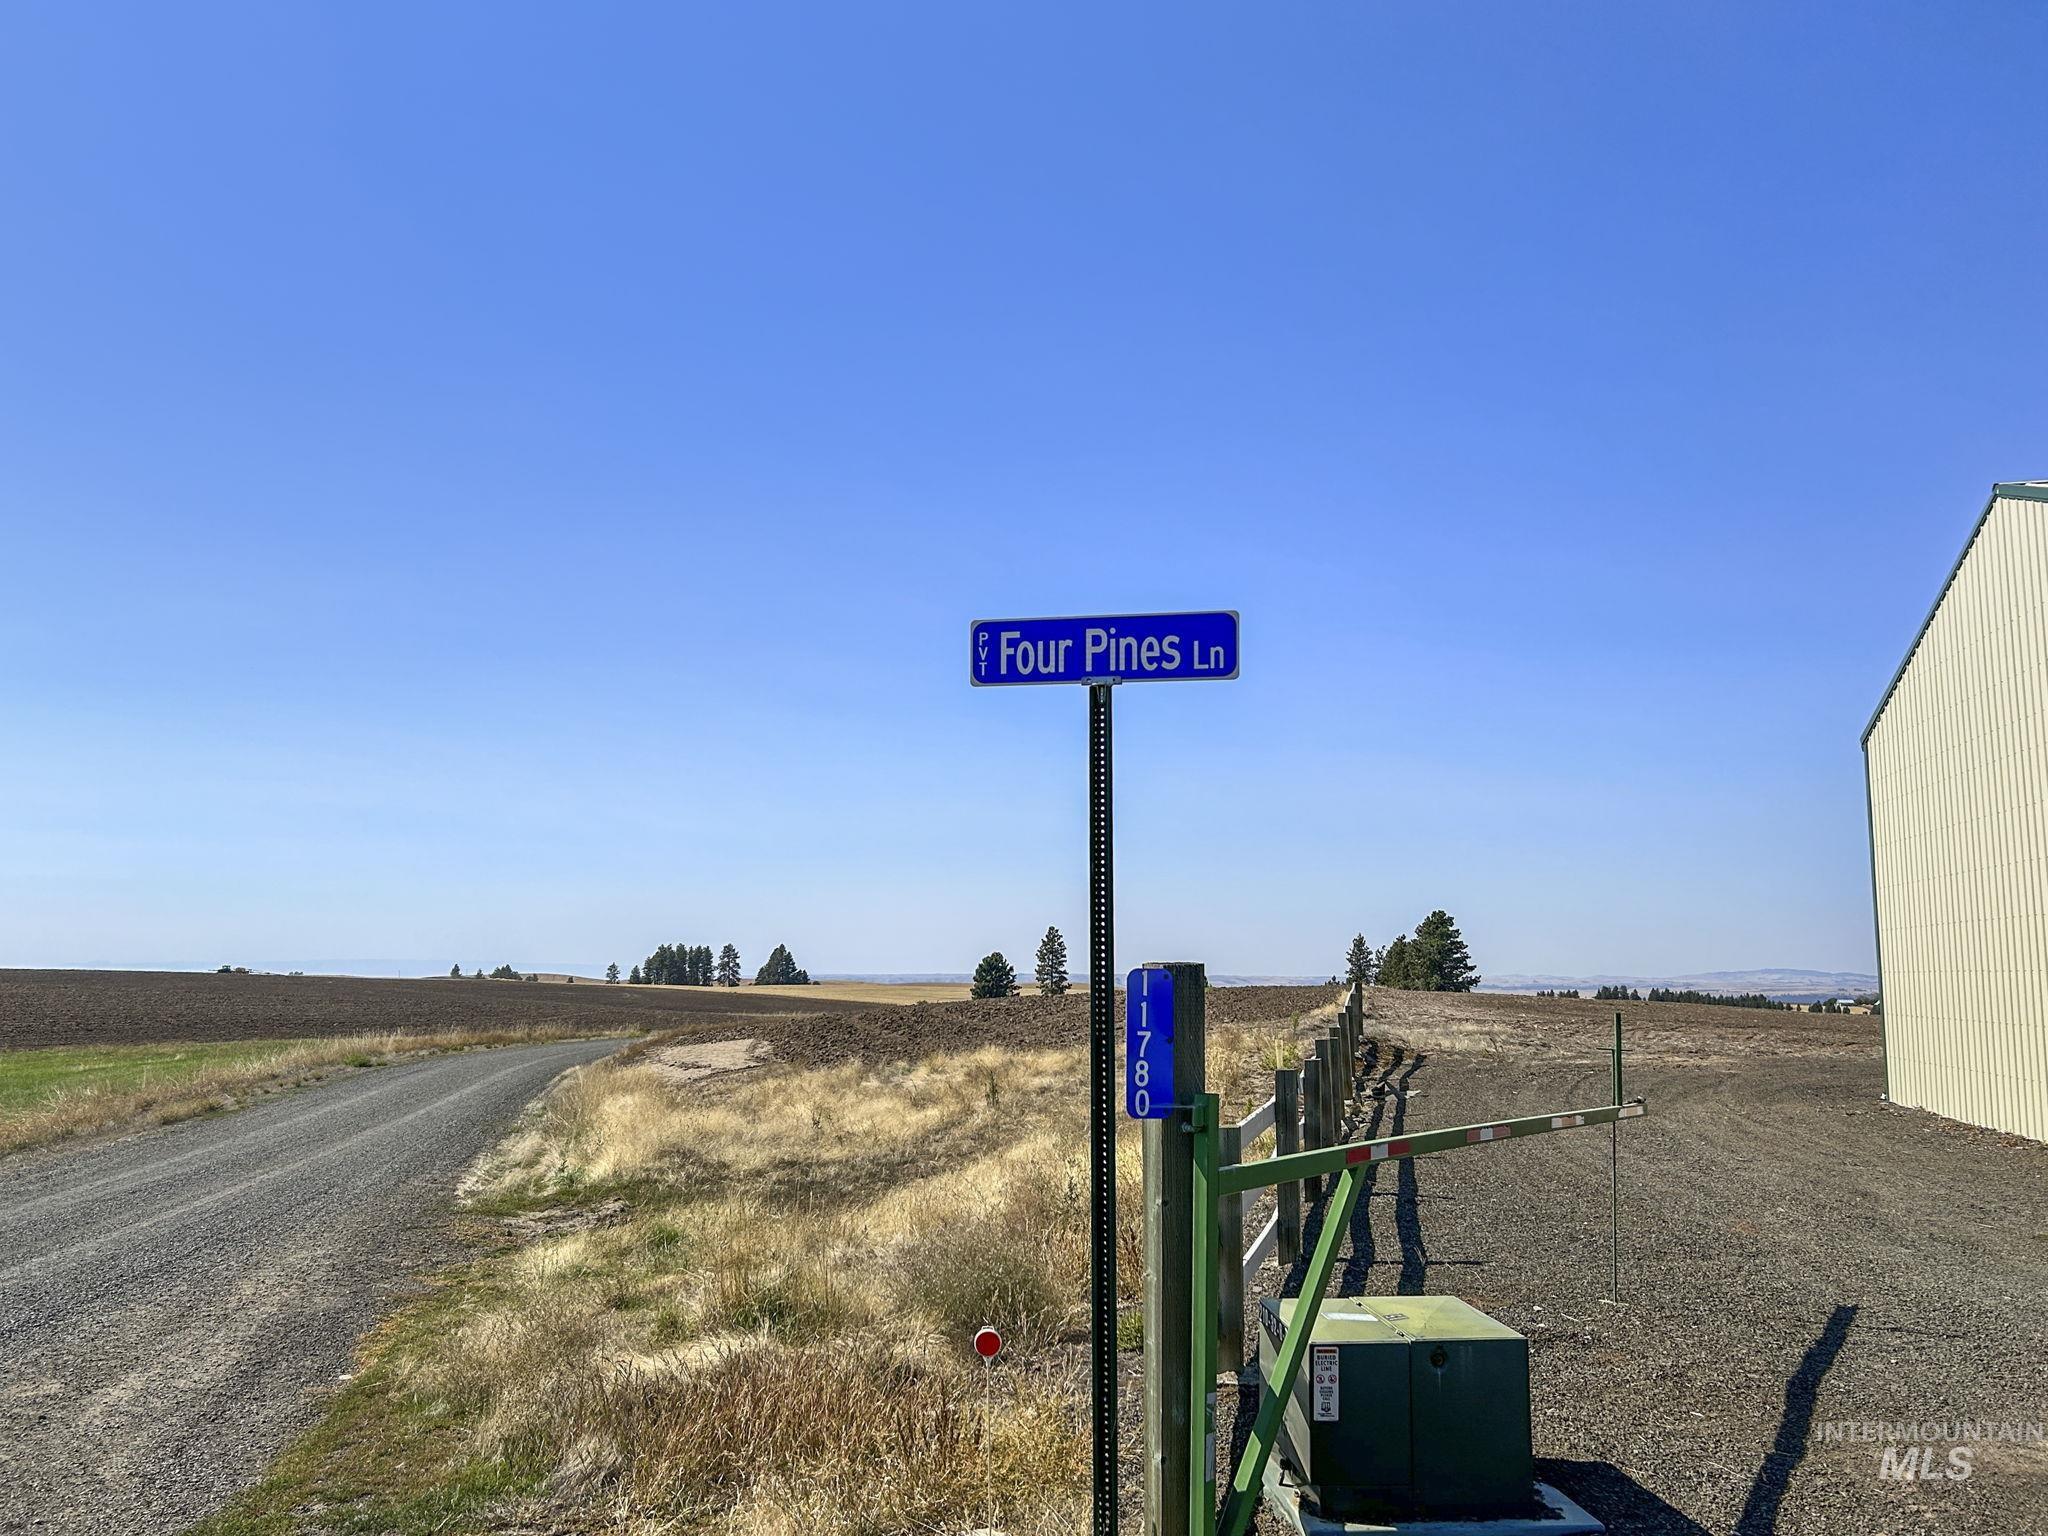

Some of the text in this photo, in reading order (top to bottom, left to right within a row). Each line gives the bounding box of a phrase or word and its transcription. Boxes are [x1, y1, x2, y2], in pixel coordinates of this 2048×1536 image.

[978, 632, 989, 676] PVT
[1000, 627, 1225, 676] Four Pines Ln
[1134, 970, 1152, 1117] 11780
